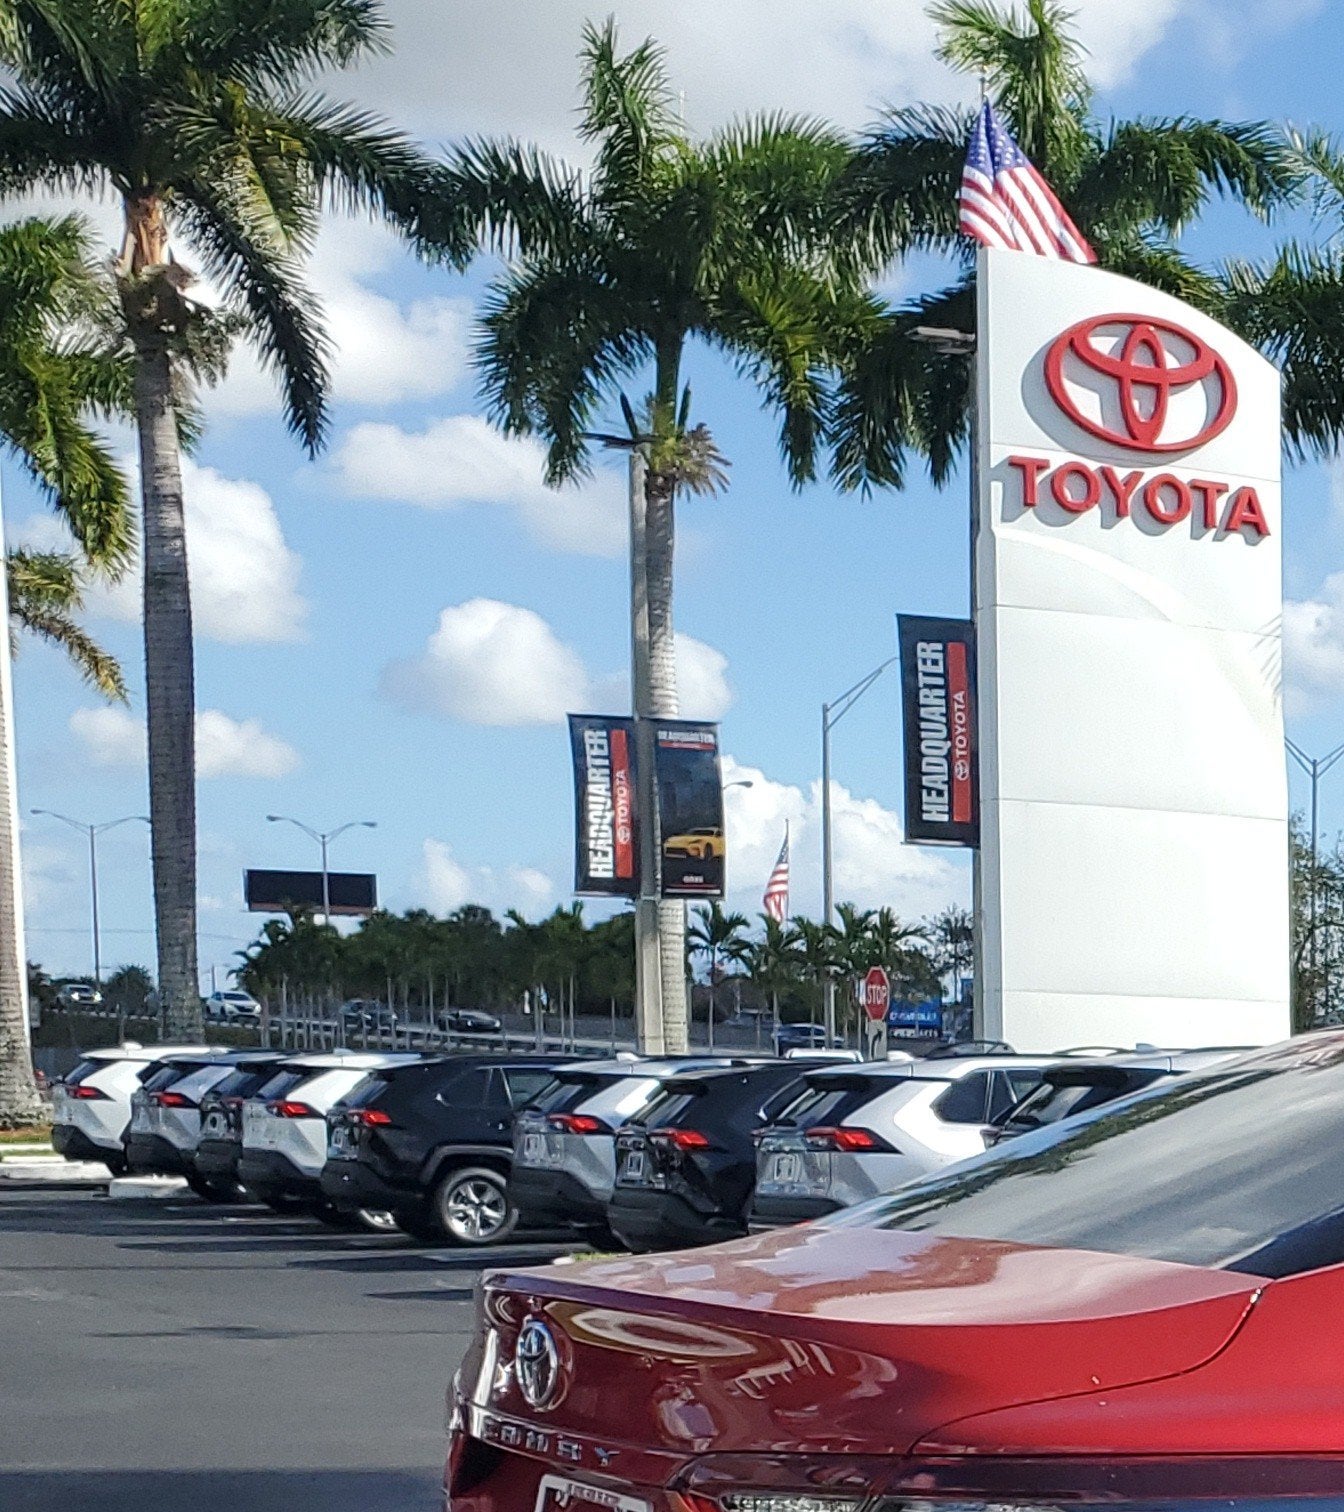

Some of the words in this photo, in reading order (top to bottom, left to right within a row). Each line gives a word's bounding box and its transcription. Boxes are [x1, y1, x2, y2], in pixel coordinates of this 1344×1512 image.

[1008, 455, 1271, 536] TOYOTA
[916, 641, 951, 823] HEADQUARTER
[953, 690, 968, 759] TOYOTA
[584, 729, 615, 878] HEADQUARTER
[616, 768, 631, 828] TOYOTA
[867, 983, 887, 1005] STOP
